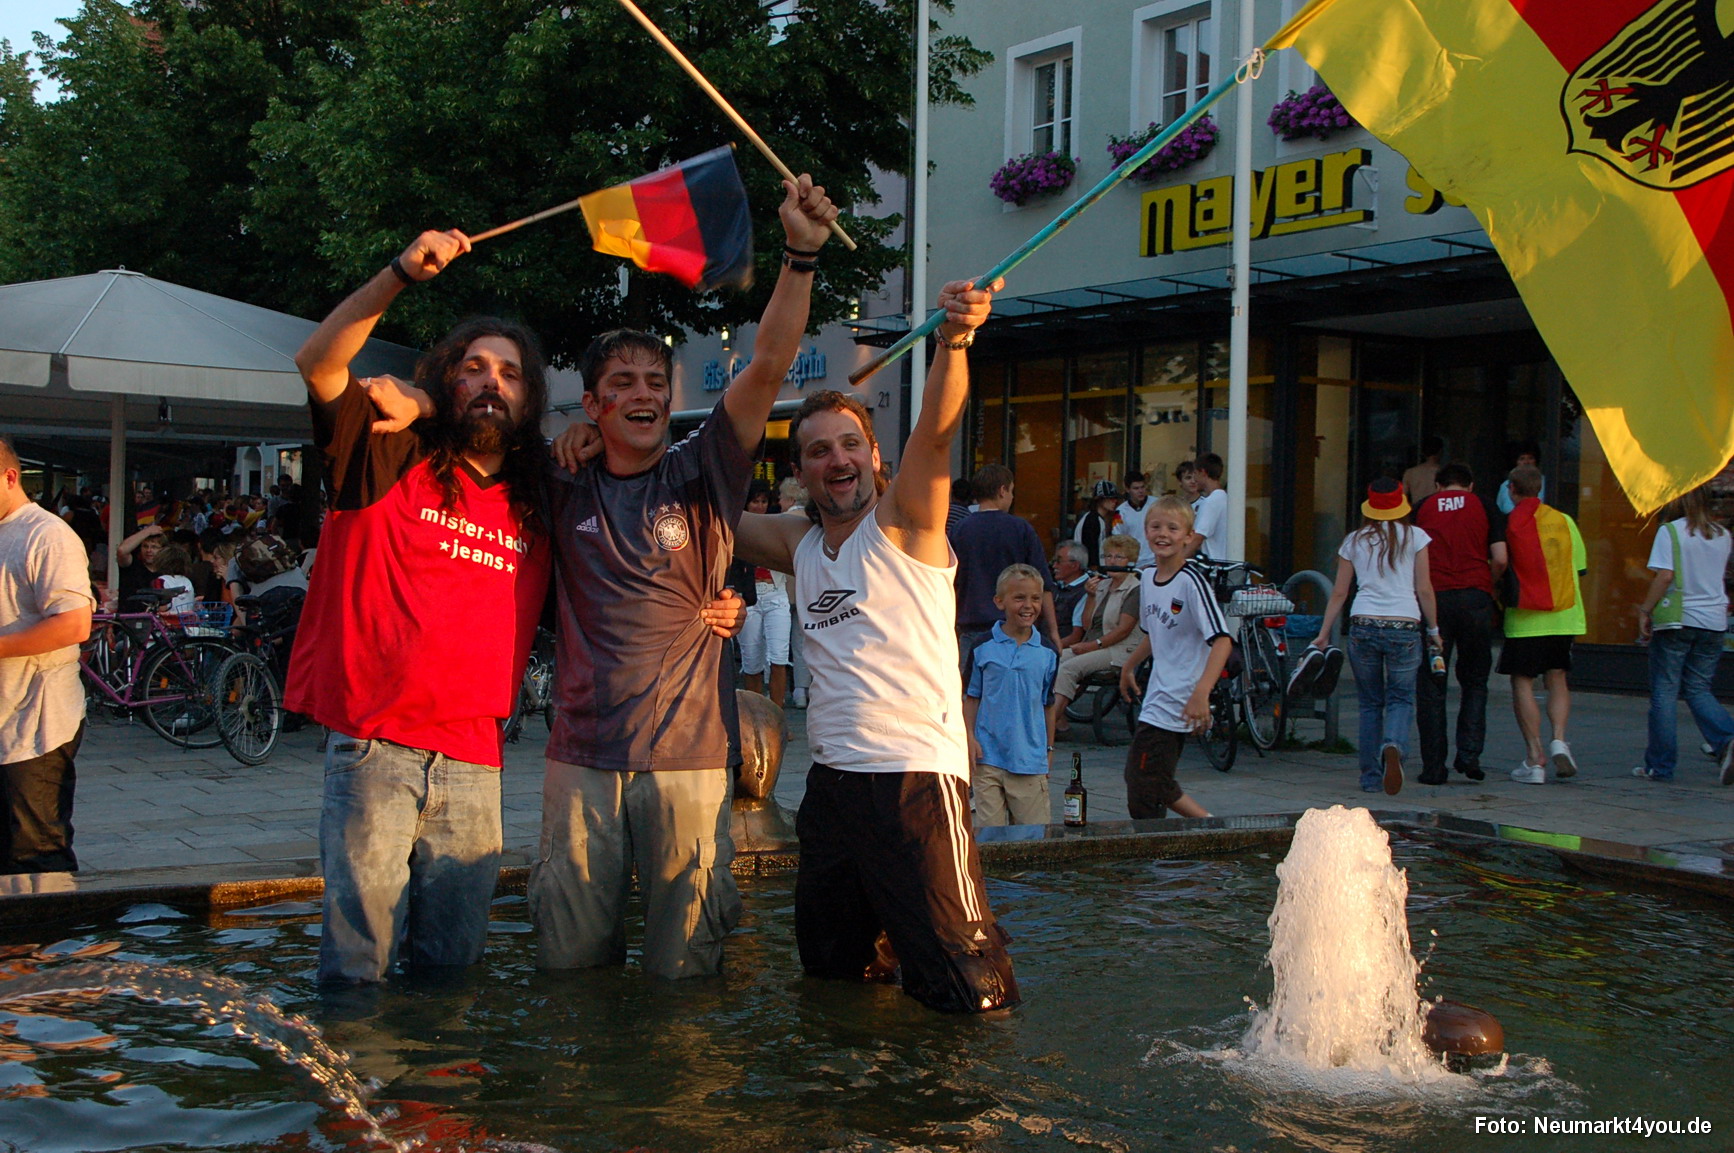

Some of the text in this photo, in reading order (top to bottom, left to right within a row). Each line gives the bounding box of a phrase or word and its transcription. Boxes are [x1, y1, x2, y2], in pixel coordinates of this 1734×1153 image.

[1139, 148, 1373, 257] mayer
[878, 391, 891, 408] 21
[1437, 496, 1465, 512] FAN
[576, 525, 599, 533] adidas
[450, 539, 504, 570] jeans
[804, 607, 860, 630] UMBRO
